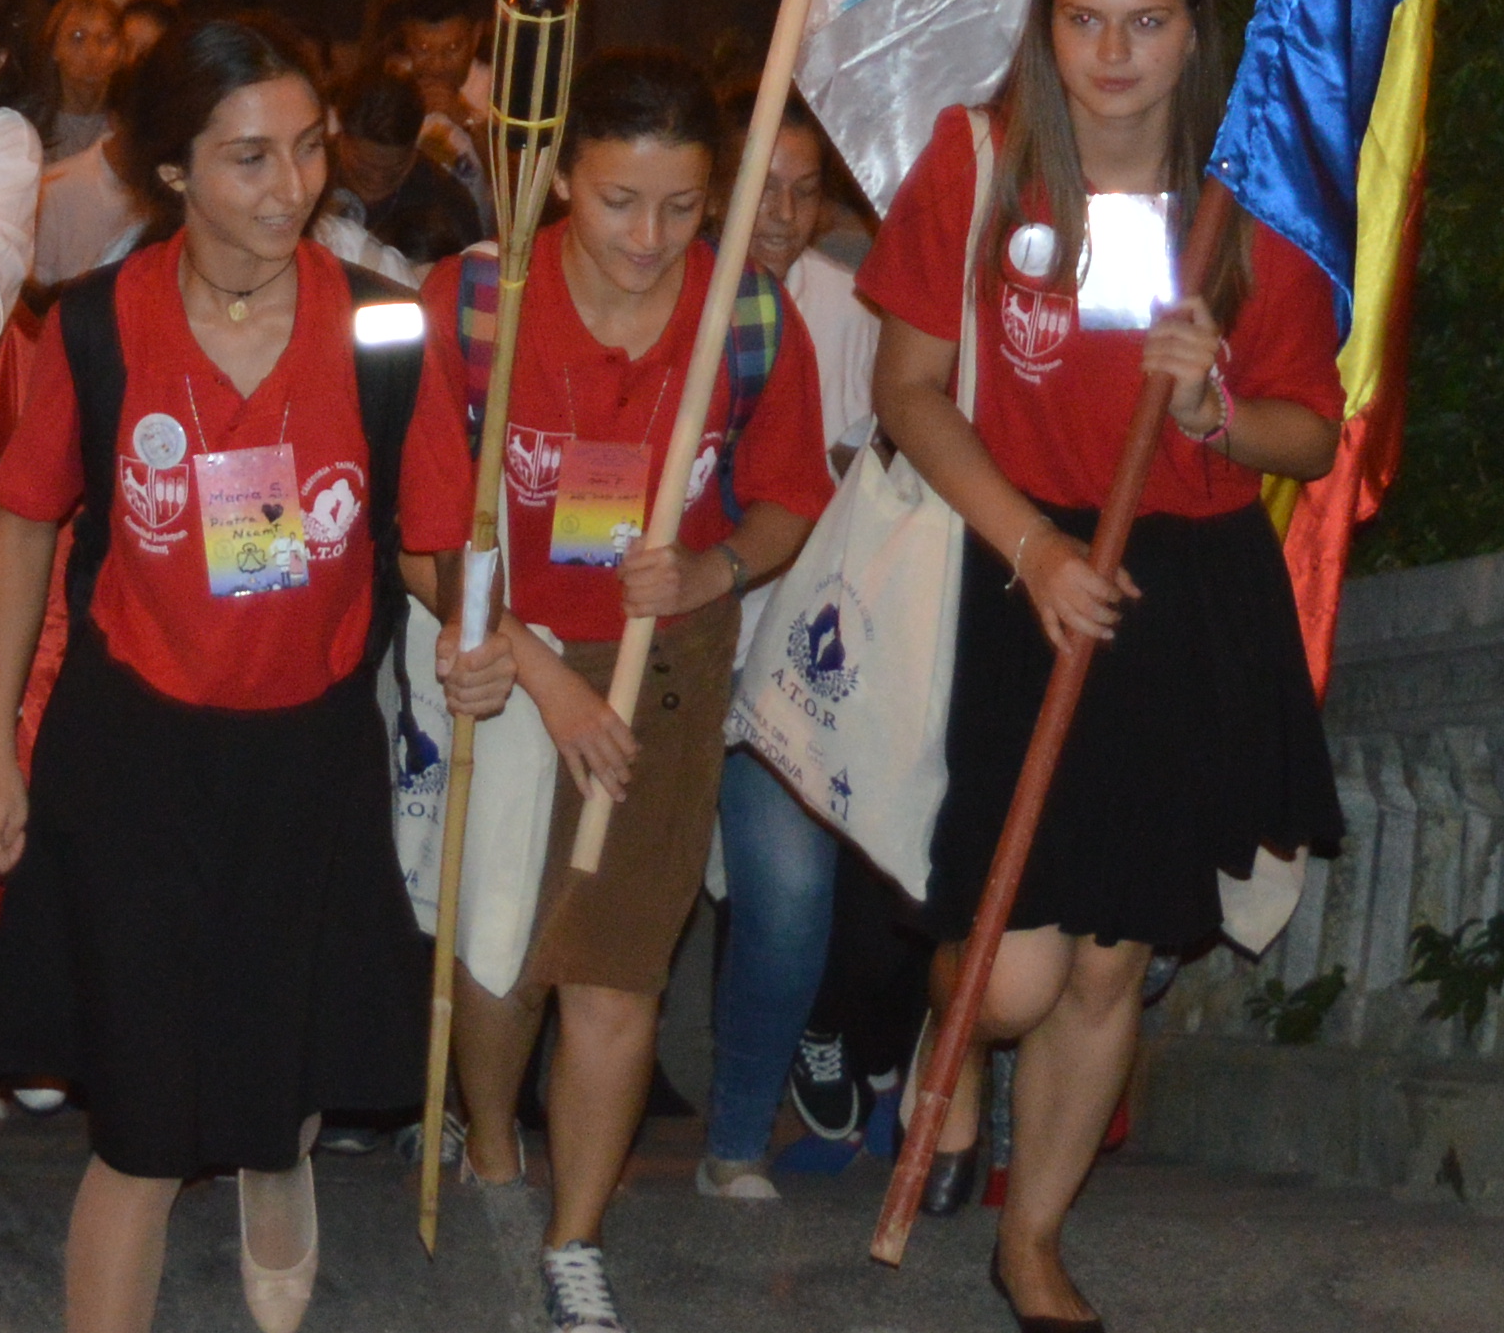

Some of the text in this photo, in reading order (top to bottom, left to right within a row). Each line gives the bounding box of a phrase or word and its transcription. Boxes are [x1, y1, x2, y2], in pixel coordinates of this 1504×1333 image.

[209, 490, 262, 505] Maria
[771, 668, 838, 732] A.T.O.R
[730, 707, 804, 785] PETRODAVA
